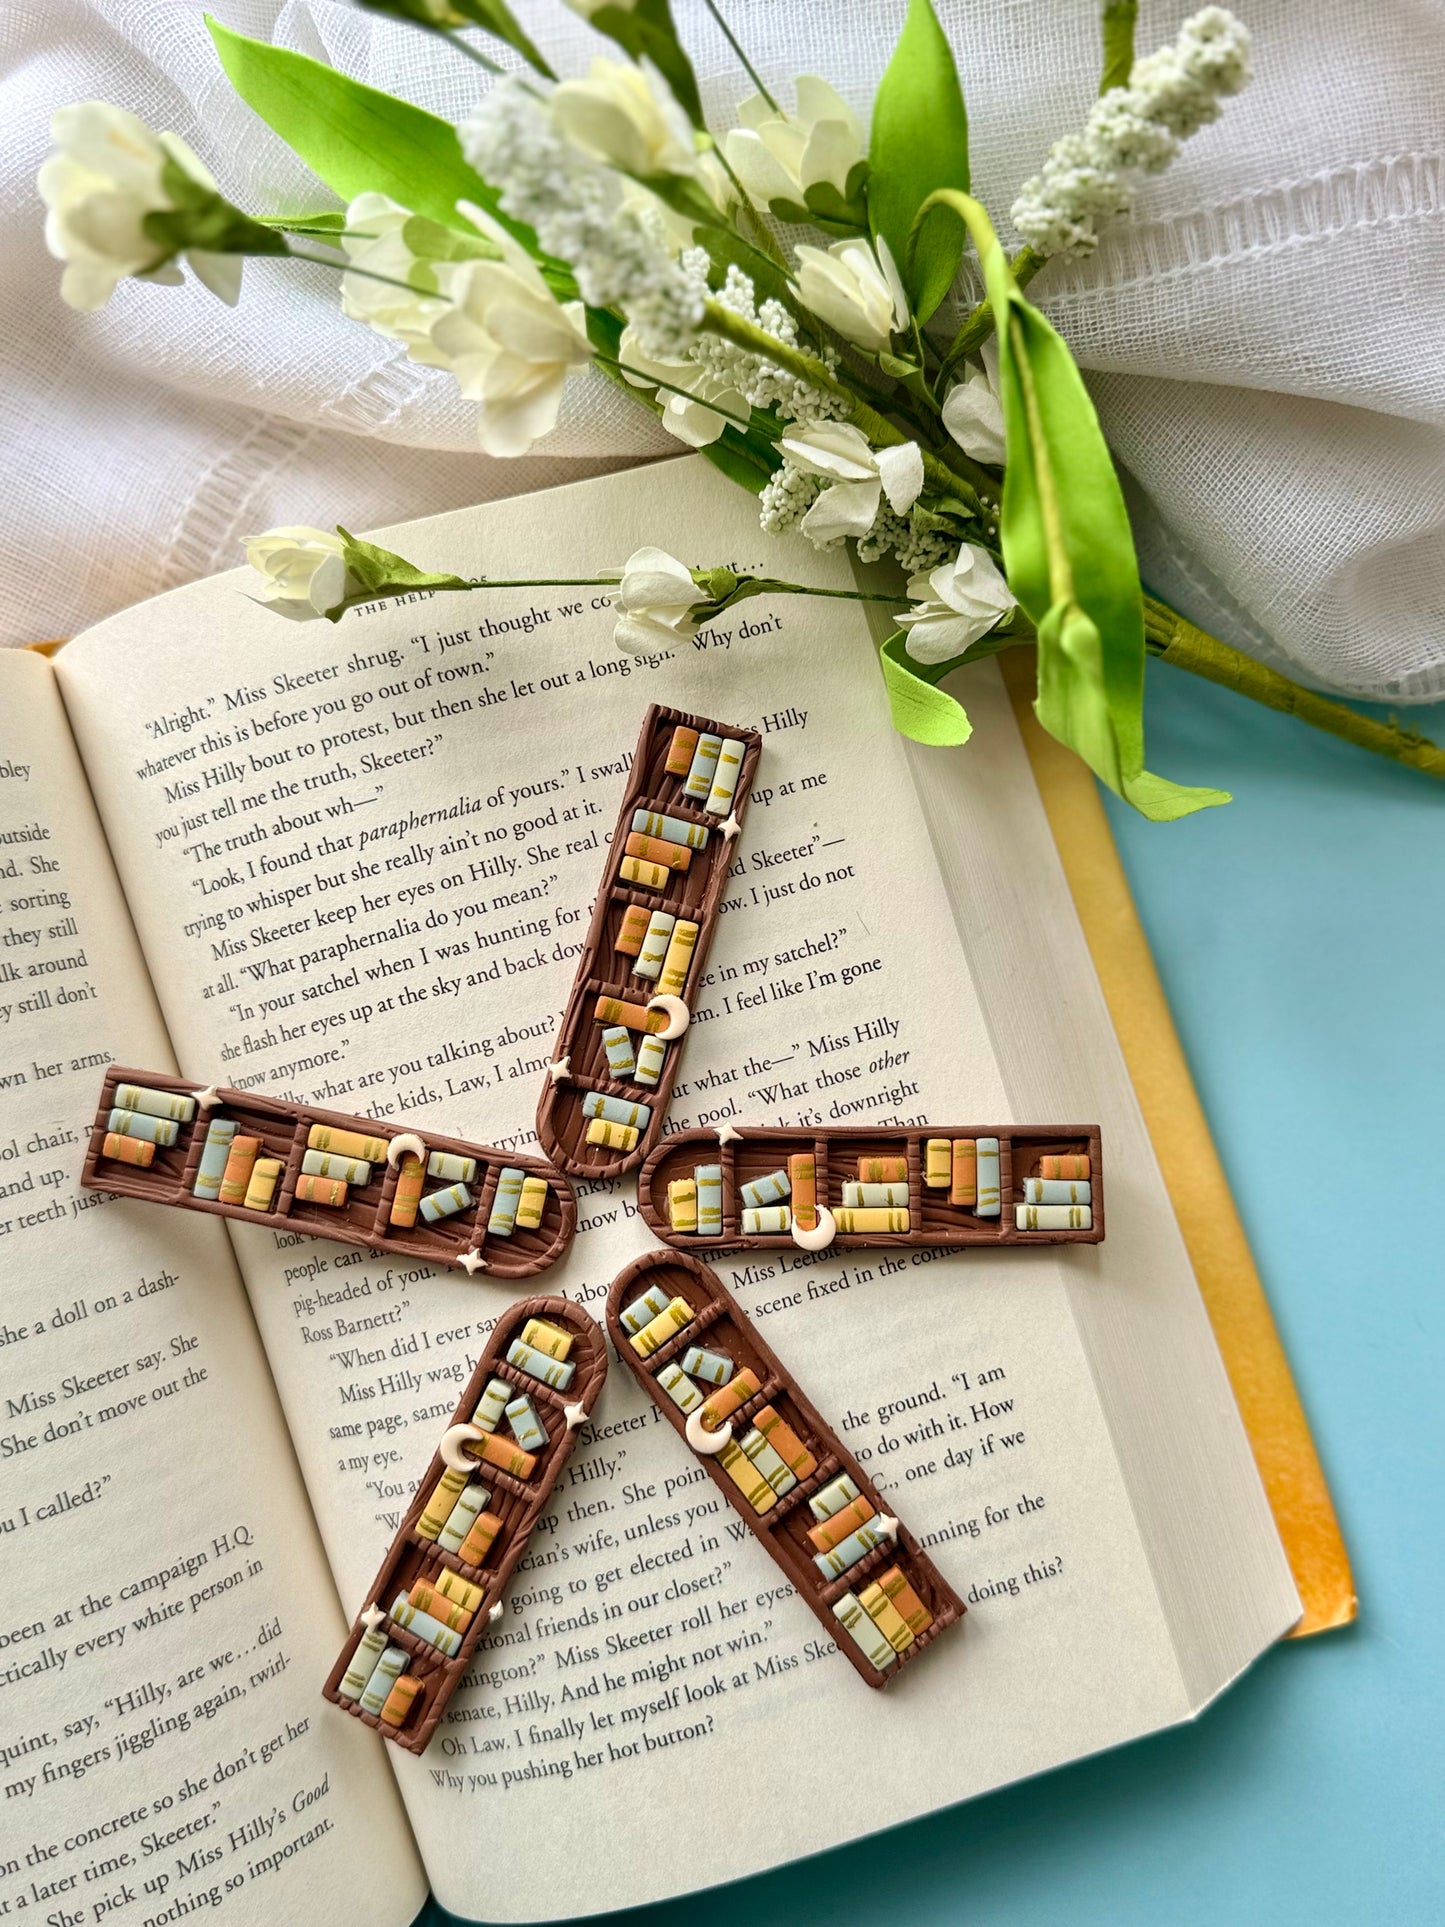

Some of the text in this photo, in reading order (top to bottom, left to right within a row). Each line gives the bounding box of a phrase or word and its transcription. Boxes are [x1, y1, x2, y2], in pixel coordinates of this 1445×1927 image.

[354, 589, 436, 617] THE HELP
[223, 686, 267, 712] Miss
[272, 665, 339, 695] Skeeter
[347, 649, 405, 674] shrug.
[436, 629, 473, 656] just
[478, 606, 553, 639] thought
[557, 602, 584, 618] we
[136, 746, 197, 781] whatever
[199, 731, 233, 755] this
[233, 725, 250, 743] is
[249, 709, 309, 737] before
[311, 698, 348, 724] you
[350, 691, 374, 713] go
[378, 680, 411, 699] out
[413, 667, 433, 690] of
[245, 860, 257, 879] I
[259, 841, 314, 875] found
[315, 835, 355, 857] that
[358, 796, 483, 852] paraphernalia
[486, 785, 506, 808] of
[575, 765, 587, 784] I
[761, 707, 809, 734] Hilly
[9, 888, 72, 912] sorting
[29, 855, 61, 875] She
[210, 773, 828, 962] Miss Skeeter keep her eyes on Hilly. She real up at me
[0, 916, 79, 948] they still
[26, 948, 89, 977] around
[220, 865, 856, 1062] she flash her eyes up at the sky and back I just do not
[17, 989, 53, 1014] still
[31, 1051, 116, 1081] her arms.
[662, 1116, 690, 1134] the
[697, 1097, 743, 1128] pool.
[814, 1066, 862, 1090] those
[869, 1049, 911, 1074] other
[693, 1068, 739, 1091] what
[806, 1034, 851, 1058] Miss
[852, 1016, 900, 1044] Hilly
[26, 1127, 79, 1154] chair,
[38, 1169, 70, 1189] up.
[16, 1199, 68, 1229] teeth
[33, 1270, 180, 1335] a doll on a dash-
[293, 1266, 437, 1318] pig-headed of you.
[5, 1334, 199, 1420] Miss Skeeter say. She
[300, 1326, 334, 1344] Ross
[329, 1255, 907, 1440] same page, same scene fixed in the
[338, 1265, 776, 1405] Miss Hilly wag Miss
[0, 1434, 39, 1459] She
[97, 1394, 148, 1424] move
[151, 1380, 181, 1401] out
[182, 1366, 209, 1388] the
[566, 1500, 615, 1522] then.
[622, 1482, 657, 1506] She
[841, 1410, 871, 1432] the
[877, 1381, 947, 1426] ground.
[977, 1367, 1007, 1386] am
[572, 1398, 1014, 1556] wife, unless you to do with it. How
[52, 1525, 254, 1629] at the campaign H.Q.
[74, 1559, 264, 1658] every white person in
[553, 1493, 1046, 1670] Miss Skeeter roll her for the
[967, 1555, 1063, 1604] doing this?
[4, 1651, 291, 1800] my fingers jiggling again, twirl-
[429, 1714, 714, 1794] Why you pushing her hot button?
[24, 1843, 60, 1867] the
[64, 1806, 150, 1852] concrete
[152, 1795, 174, 1815] so
[178, 1777, 210, 1803] she
[260, 1734, 286, 1765] get
[284, 1717, 310, 1743] her
[92, 1883, 138, 1924] pick
[143, 1873, 170, 1896] up
[175, 1846, 224, 1881] Miss
[292, 1771, 330, 1815] Good
